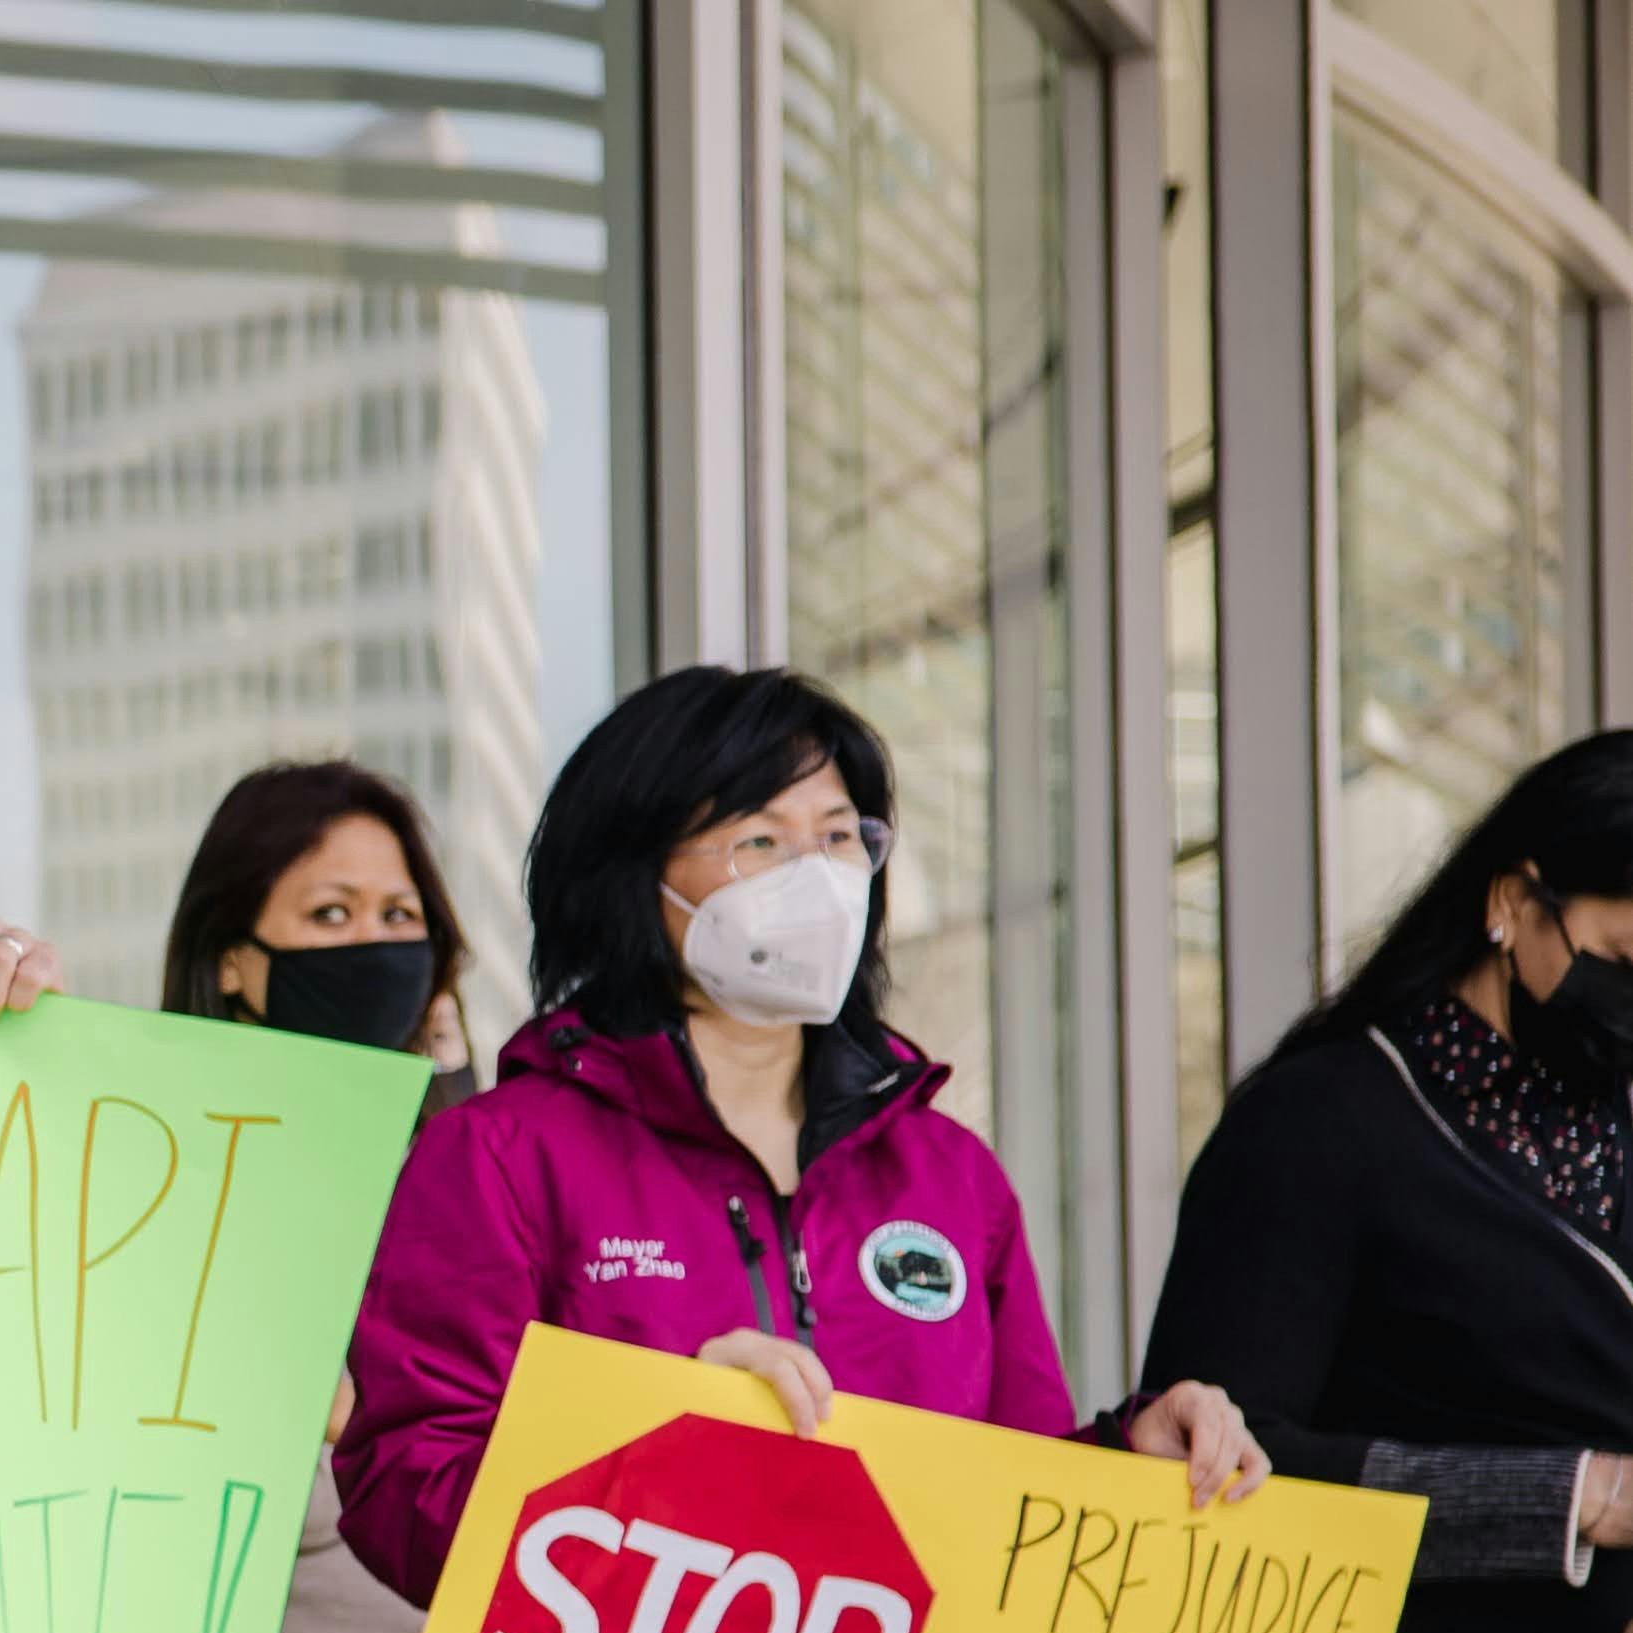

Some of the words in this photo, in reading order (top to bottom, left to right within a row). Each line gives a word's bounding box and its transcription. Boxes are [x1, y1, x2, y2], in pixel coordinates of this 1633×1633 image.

[598, 1236, 665, 1259] Mayor
[583, 1259, 628, 1283] Yan
[632, 1256, 686, 1280] Zhao
